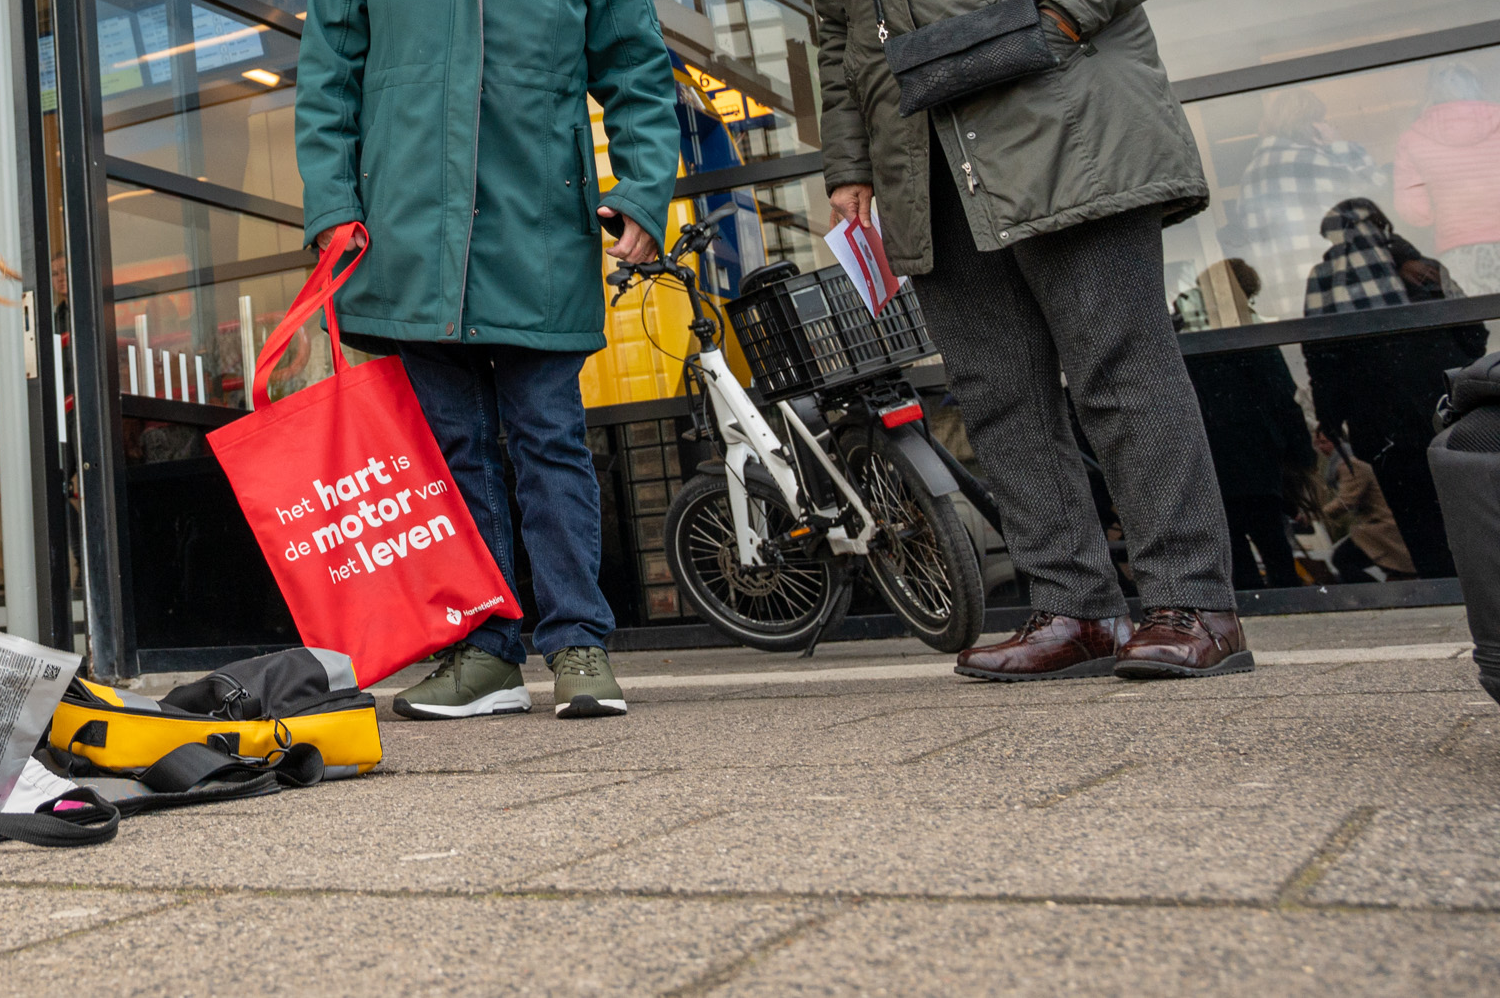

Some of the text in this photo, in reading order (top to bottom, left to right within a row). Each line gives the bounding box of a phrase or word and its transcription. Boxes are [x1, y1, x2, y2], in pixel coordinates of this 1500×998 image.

[699, 72, 710, 88] 6
[275, 455, 411, 525] het hart is
[284, 478, 448, 562] de motor van
[328, 514, 456, 585] het leven
